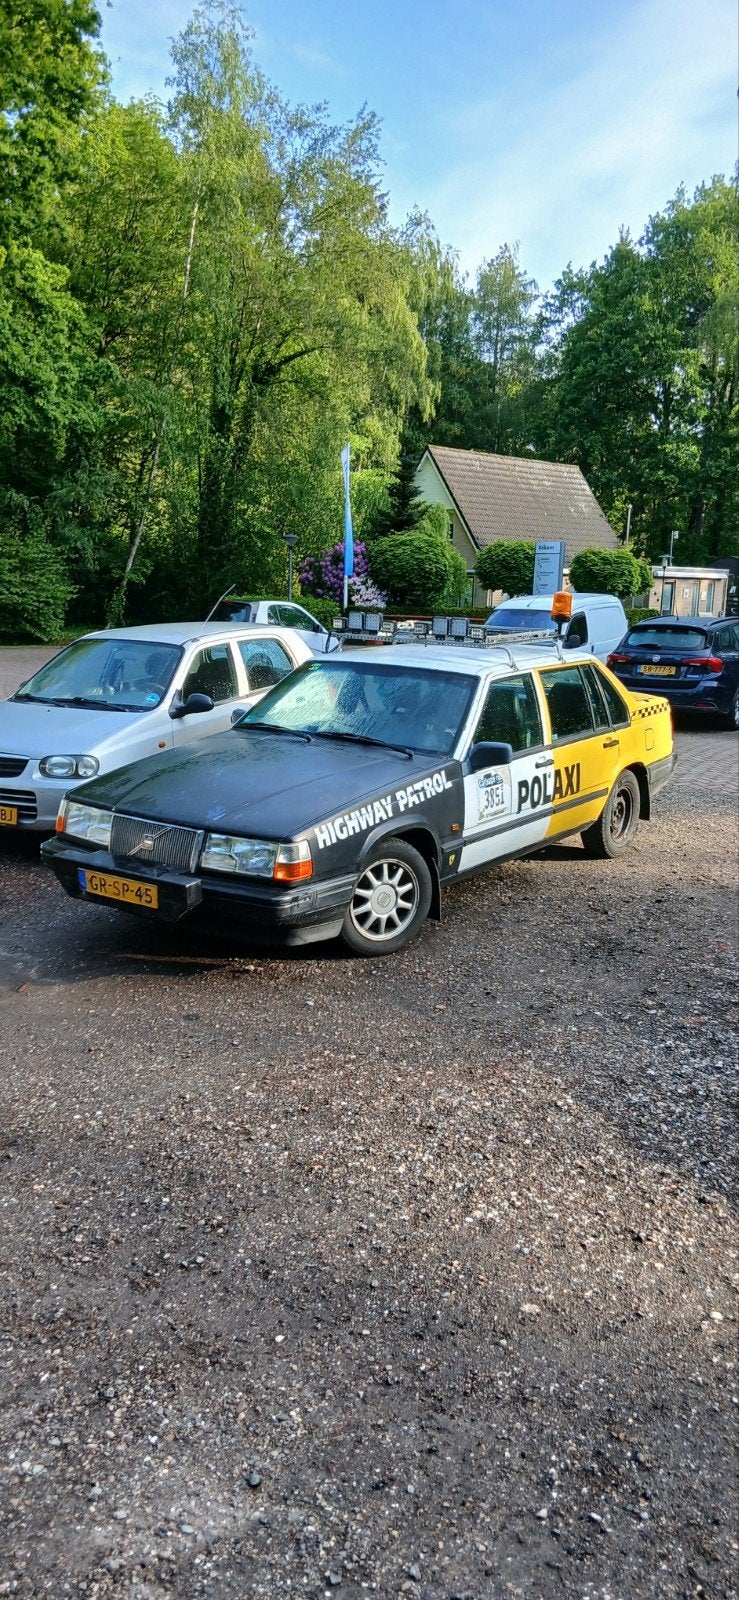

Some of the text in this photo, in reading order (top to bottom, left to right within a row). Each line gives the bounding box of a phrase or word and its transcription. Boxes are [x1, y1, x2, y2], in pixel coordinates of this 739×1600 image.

[314, 770, 453, 850] HIGHWAY PATROL
[89, 875, 153, 903] GR-SP-45
